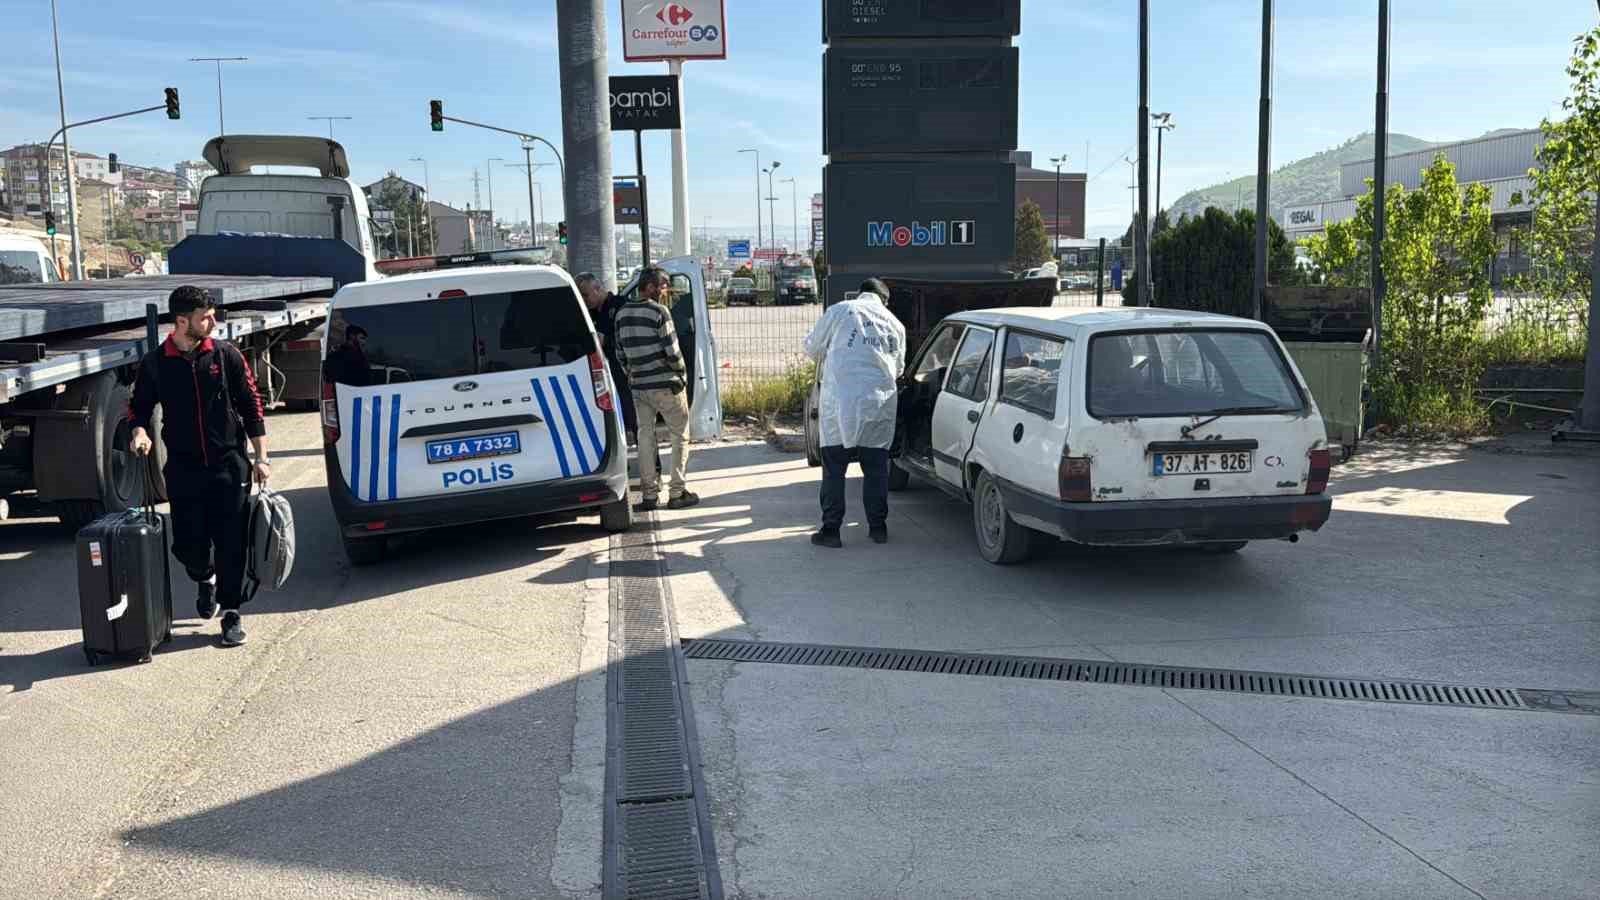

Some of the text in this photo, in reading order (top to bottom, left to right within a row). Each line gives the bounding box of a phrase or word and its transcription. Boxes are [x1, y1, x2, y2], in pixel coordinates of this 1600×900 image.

[617, 110, 658, 118] YATAK
[1289, 210, 1315, 224] REGAL
[867, 221, 946, 246] Mobil
[406, 396, 532, 415] TOURNEO
[433, 437, 513, 457] 78 A 7332
[1166, 454, 1246, 473] 37 AT 826
[442, 462, 514, 488] POLİS
